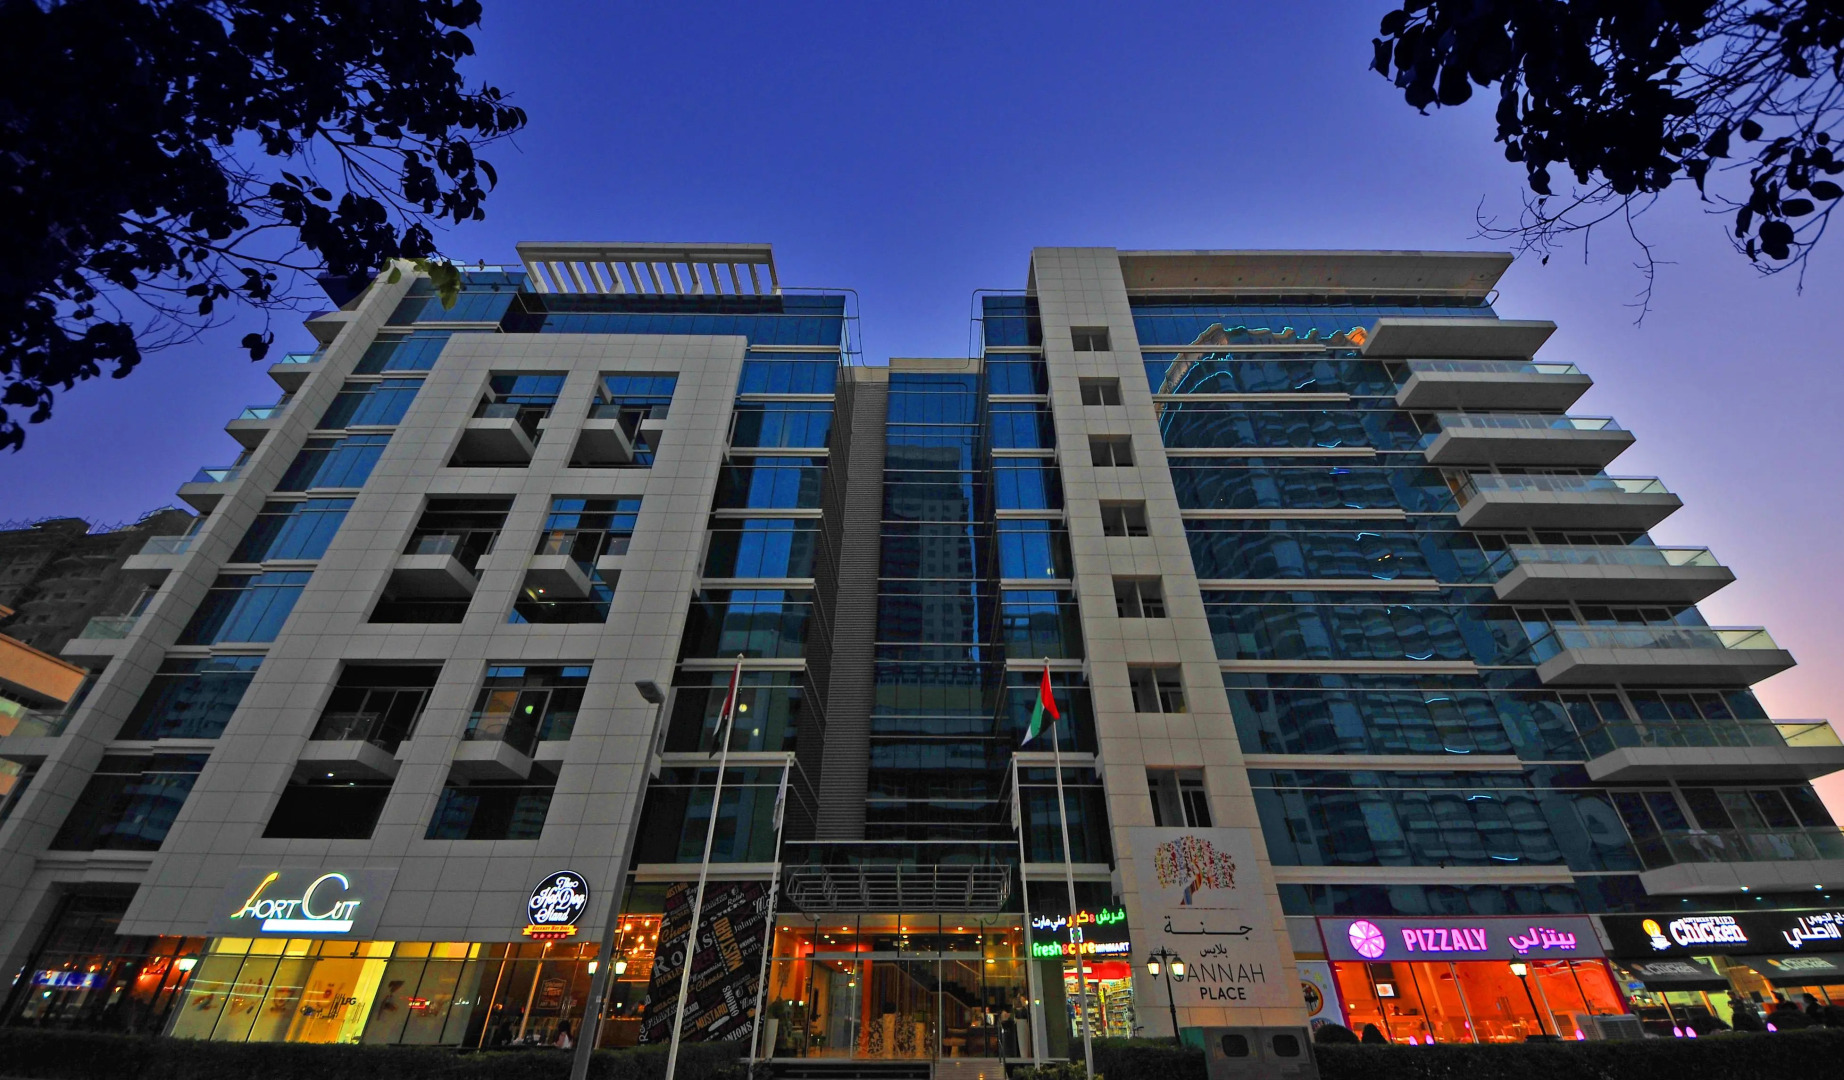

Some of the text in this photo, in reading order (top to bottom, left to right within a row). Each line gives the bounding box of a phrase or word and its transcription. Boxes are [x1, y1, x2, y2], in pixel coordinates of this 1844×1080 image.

[556, 876, 579, 890] The
[534, 904, 571, 923] Stand
[1095, 908, 1125, 924] فرش
[1710, 915, 1736, 926] FRIED
[713, 916, 744, 972] MUSTARD
[1402, 928, 1488, 952] PIZZALY
[1508, 927, 1576, 955] بيتزلي
[1200, 943, 1229, 958] بلايس
[341, 997, 357, 1006] LPG
[722, 985, 740, 1017] ONIONS
[1200, 987, 1247, 1000] PLACE
[695, 1002, 729, 1030] MUSTARD
